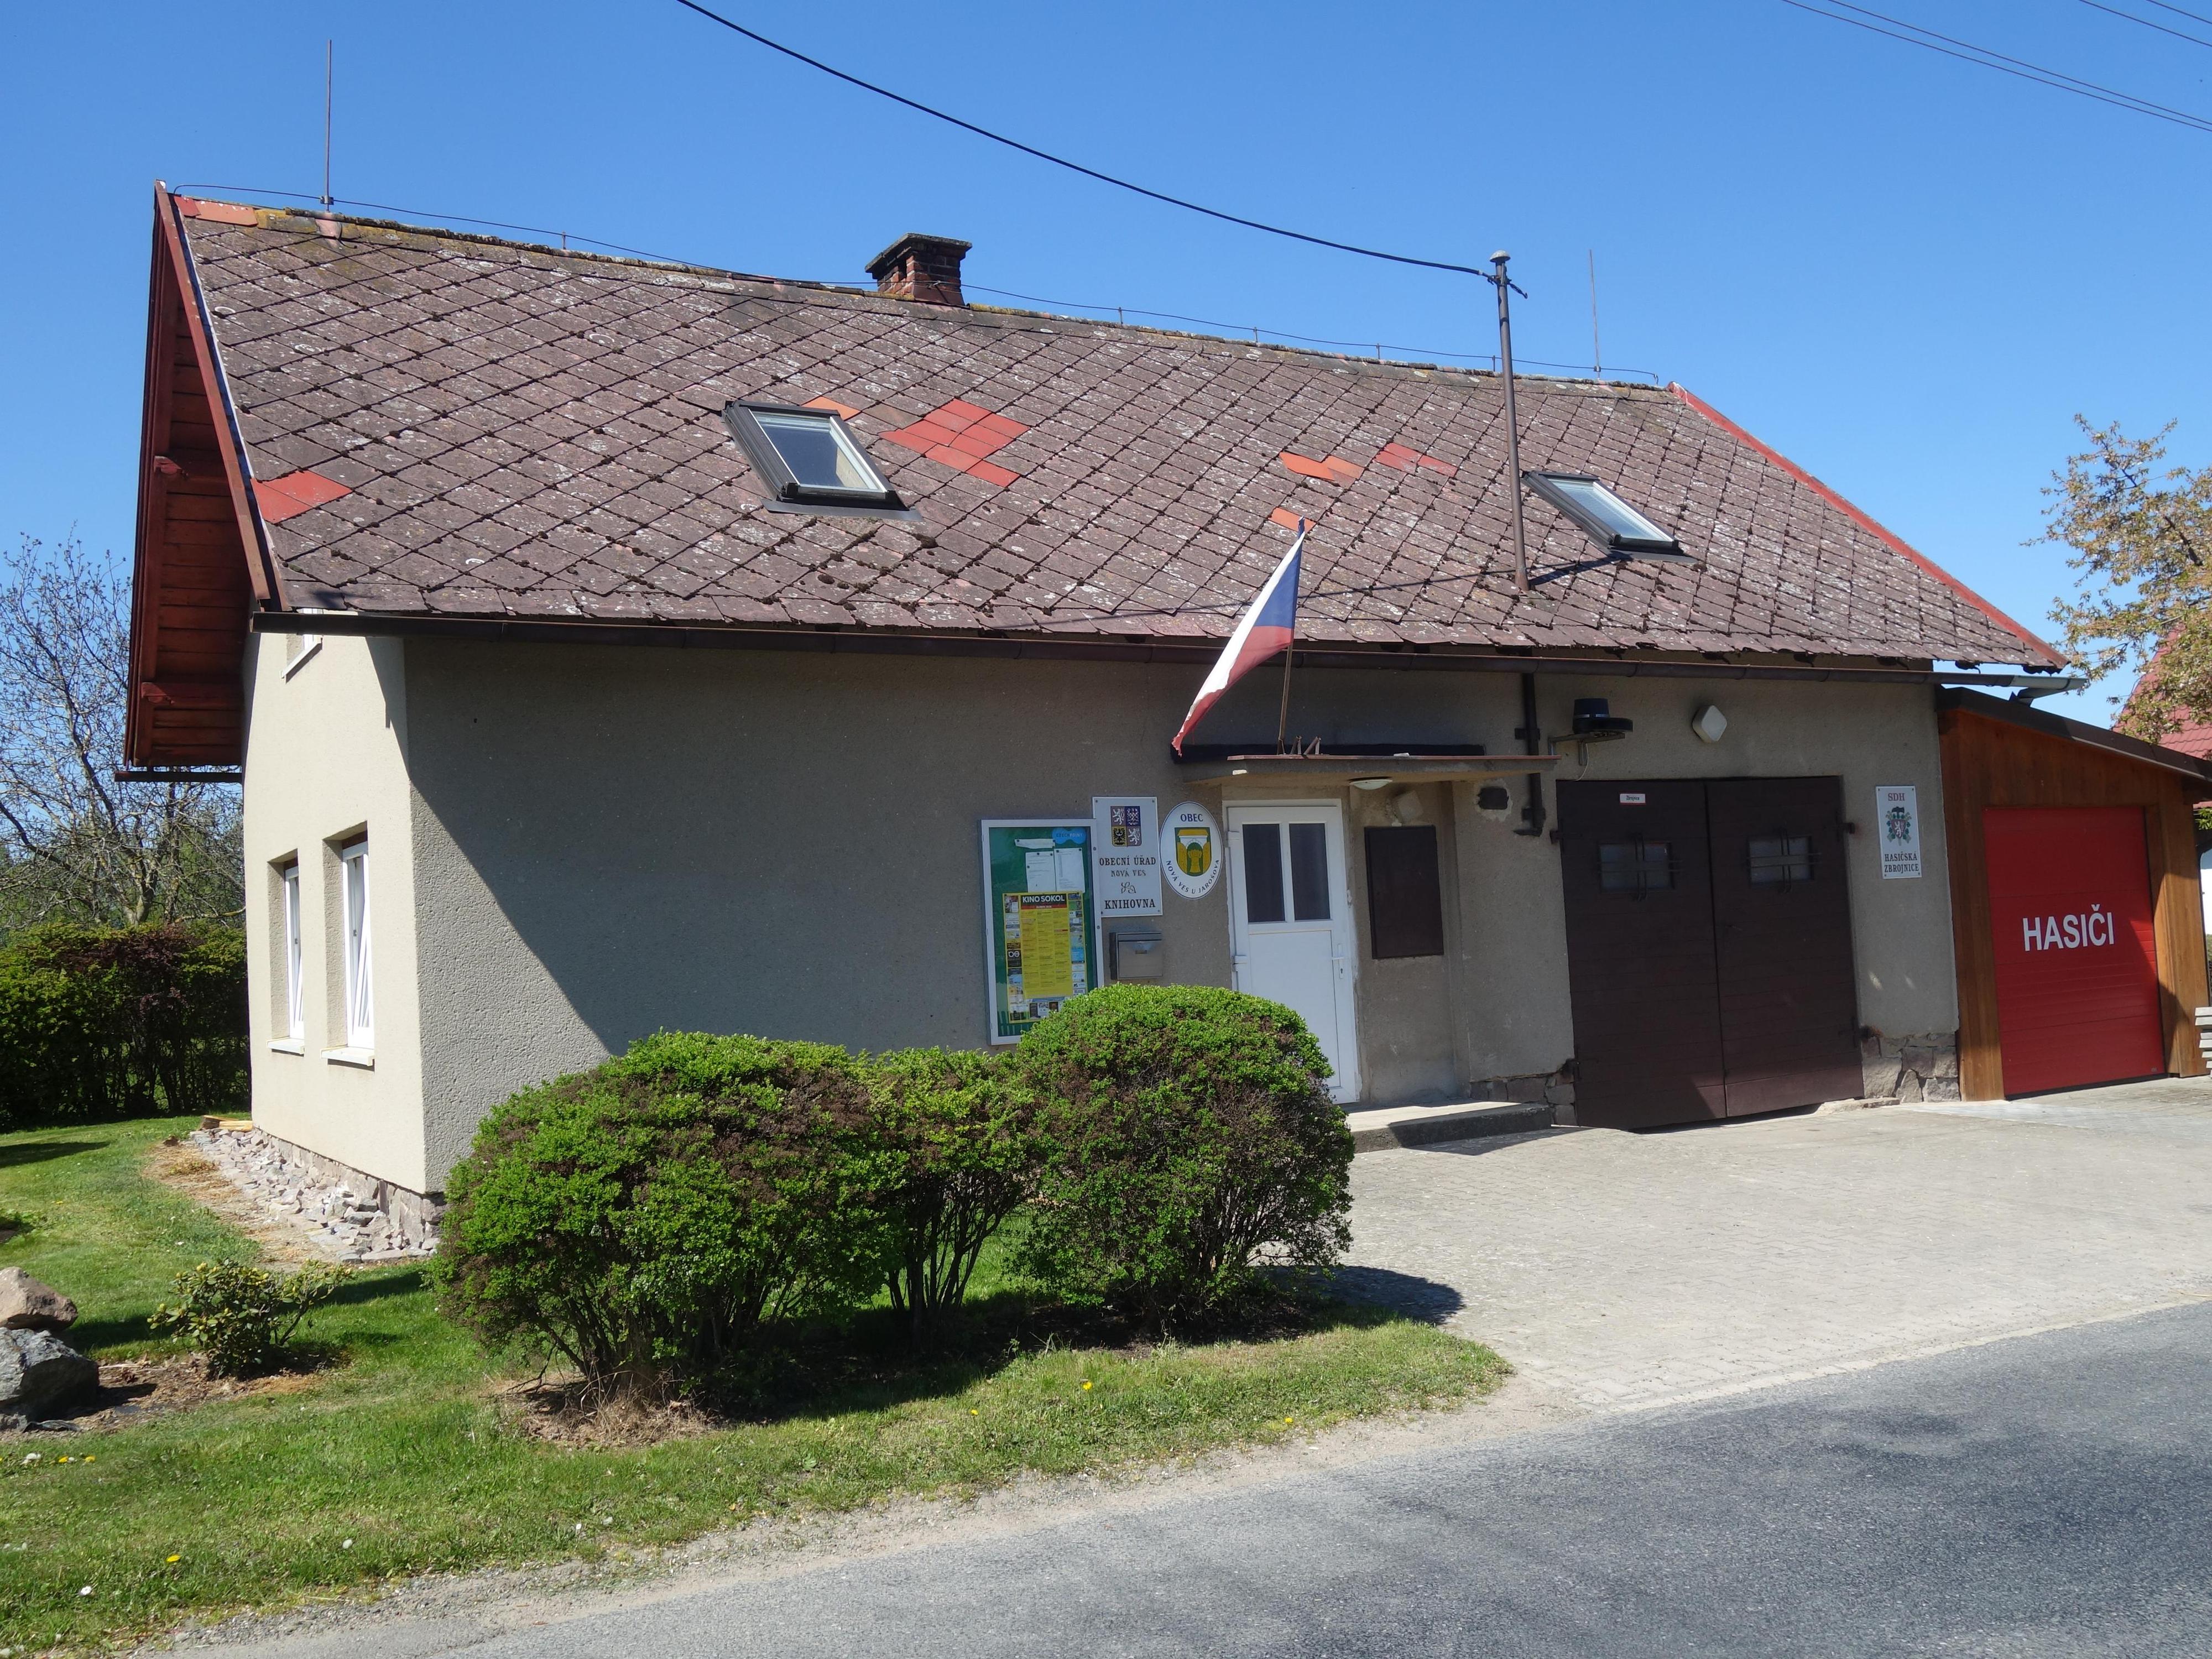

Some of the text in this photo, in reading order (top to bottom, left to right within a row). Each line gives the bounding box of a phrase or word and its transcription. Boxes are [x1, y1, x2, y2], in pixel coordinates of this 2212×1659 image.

[1888, 792, 1905, 801] SDH
[1180, 813, 1204, 822] OBEC
[1099, 855, 1156, 866] OBECNÍ ÚŘAD
[1885, 851, 1918, 862] HASIČSKÁ
[1111, 868, 1130, 877] NOVÁ
[1884, 863, 1919, 874] ZBROJNICE
[1166, 860, 1179, 881] NOVÁ
[1178, 882, 1189, 893] VES
[1104, 899, 1155, 909] KNIHOVNA
[2022, 904, 2115, 951] HASIČI
